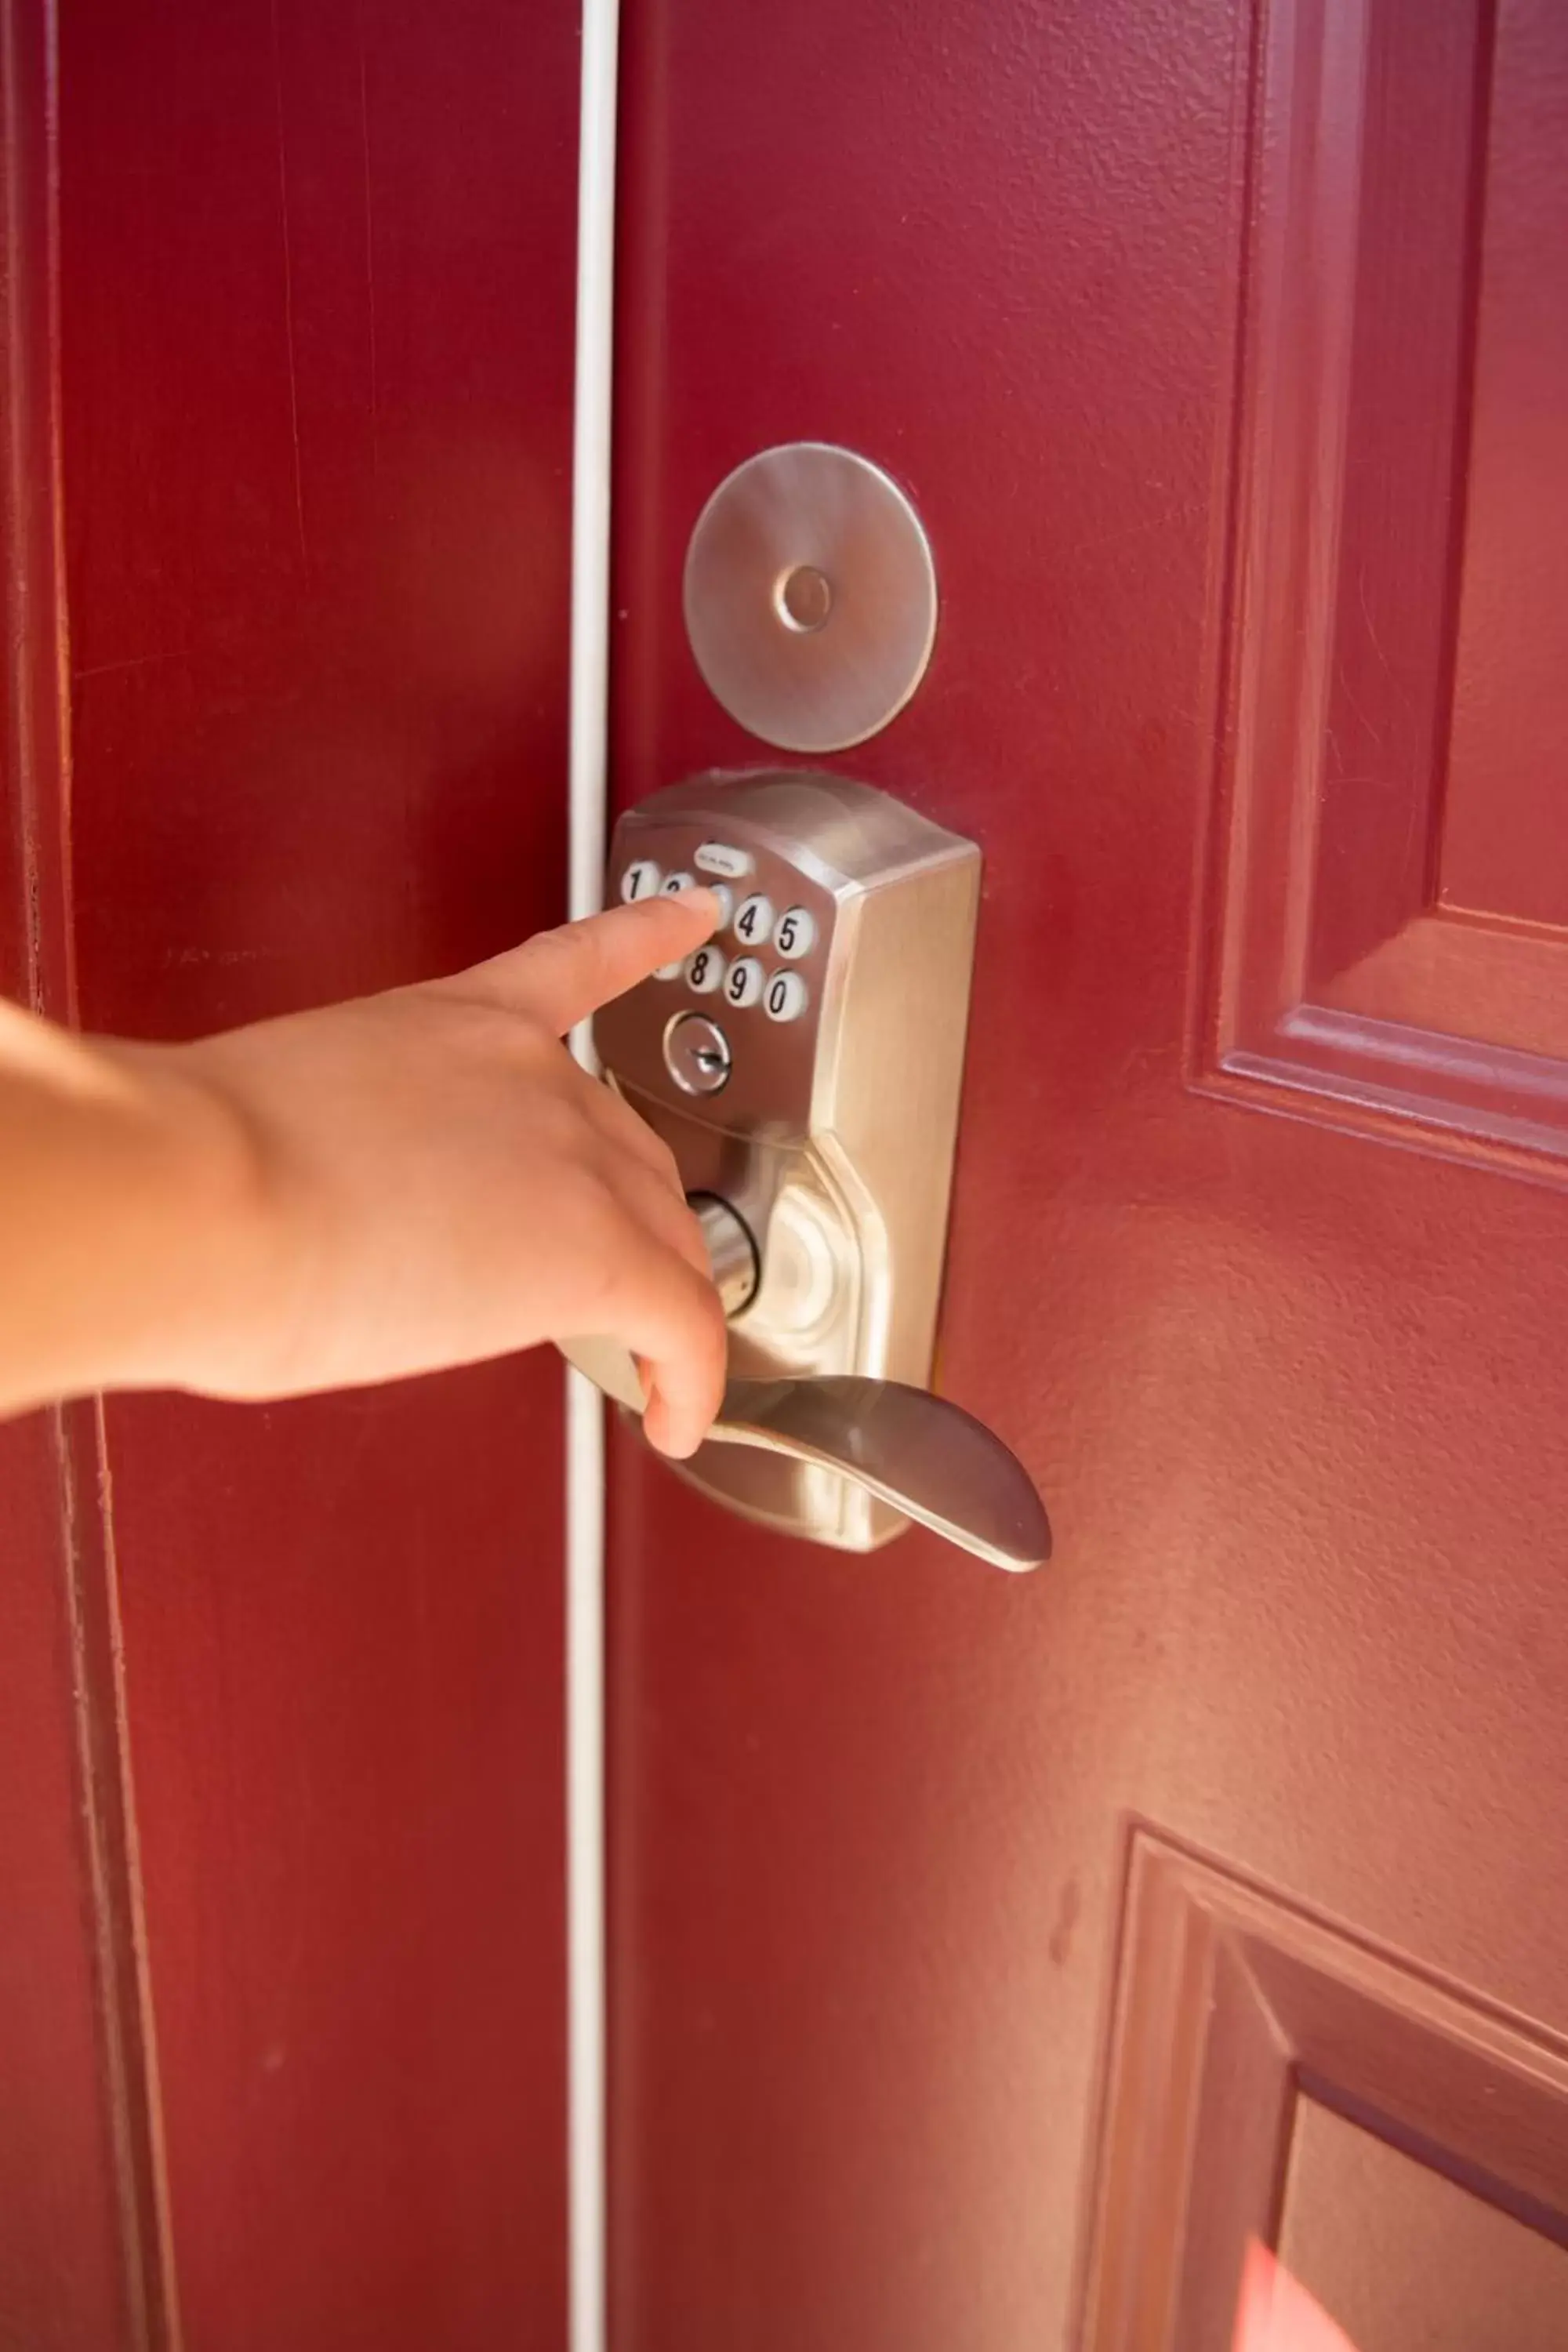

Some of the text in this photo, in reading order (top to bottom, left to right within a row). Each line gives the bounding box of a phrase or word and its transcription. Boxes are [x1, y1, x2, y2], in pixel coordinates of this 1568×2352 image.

[630, 869, 797, 951] 1 4 5
[691, 952, 786, 1014] 8 9 0
